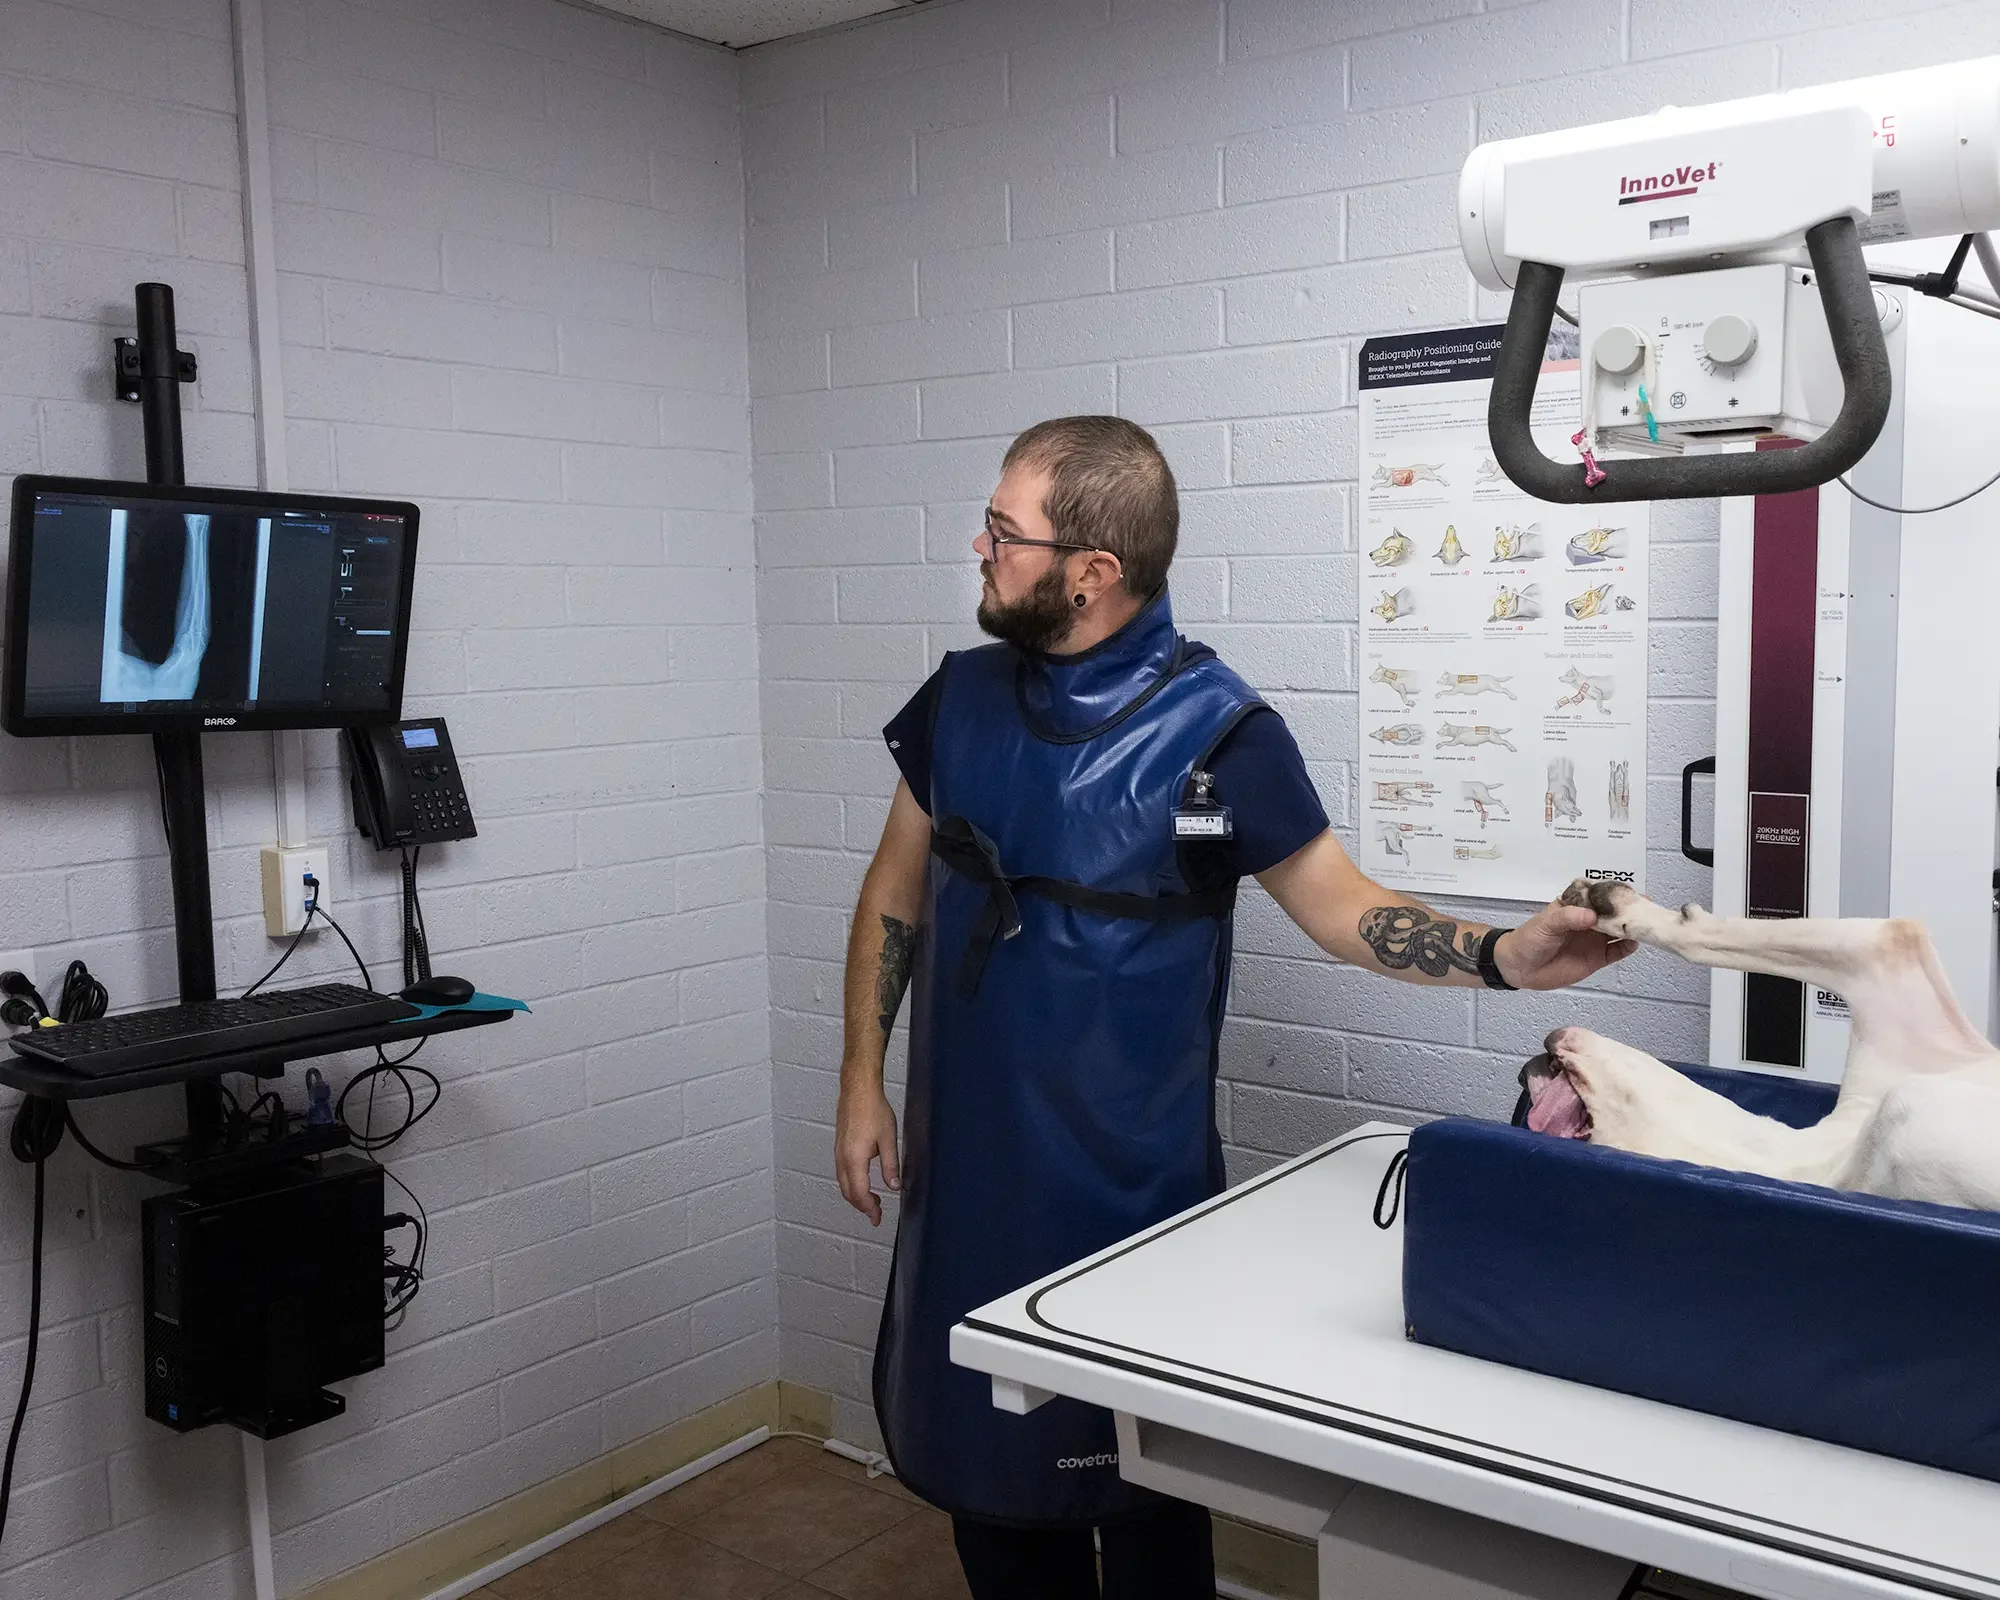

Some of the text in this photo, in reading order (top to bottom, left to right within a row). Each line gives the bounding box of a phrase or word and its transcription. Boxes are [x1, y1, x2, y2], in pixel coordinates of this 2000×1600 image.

[1882, 116, 1895, 147] UP
[1368, 339, 1502, 361] Radiography Positioning Guide
[1368, 364, 1388, 373] Brought
[1404, 362, 1412, 370] by
[1411, 361, 1430, 369] IDEXX
[1430, 358, 1457, 367] Diagnostic
[1458, 357, 1480, 365] Imaging
[1480, 354, 1491, 362] and
[1368, 368, 1451, 381] IDEXX Telemedicine Consultants
[204, 717, 237, 726] BARCO
[1755, 833, 1802, 843] FREQUENCY
[1757, 826, 1800, 836] 20KHz HIGH
[1585, 868, 1635, 883] IDEXX
[1056, 1452, 1119, 1469] covetru
